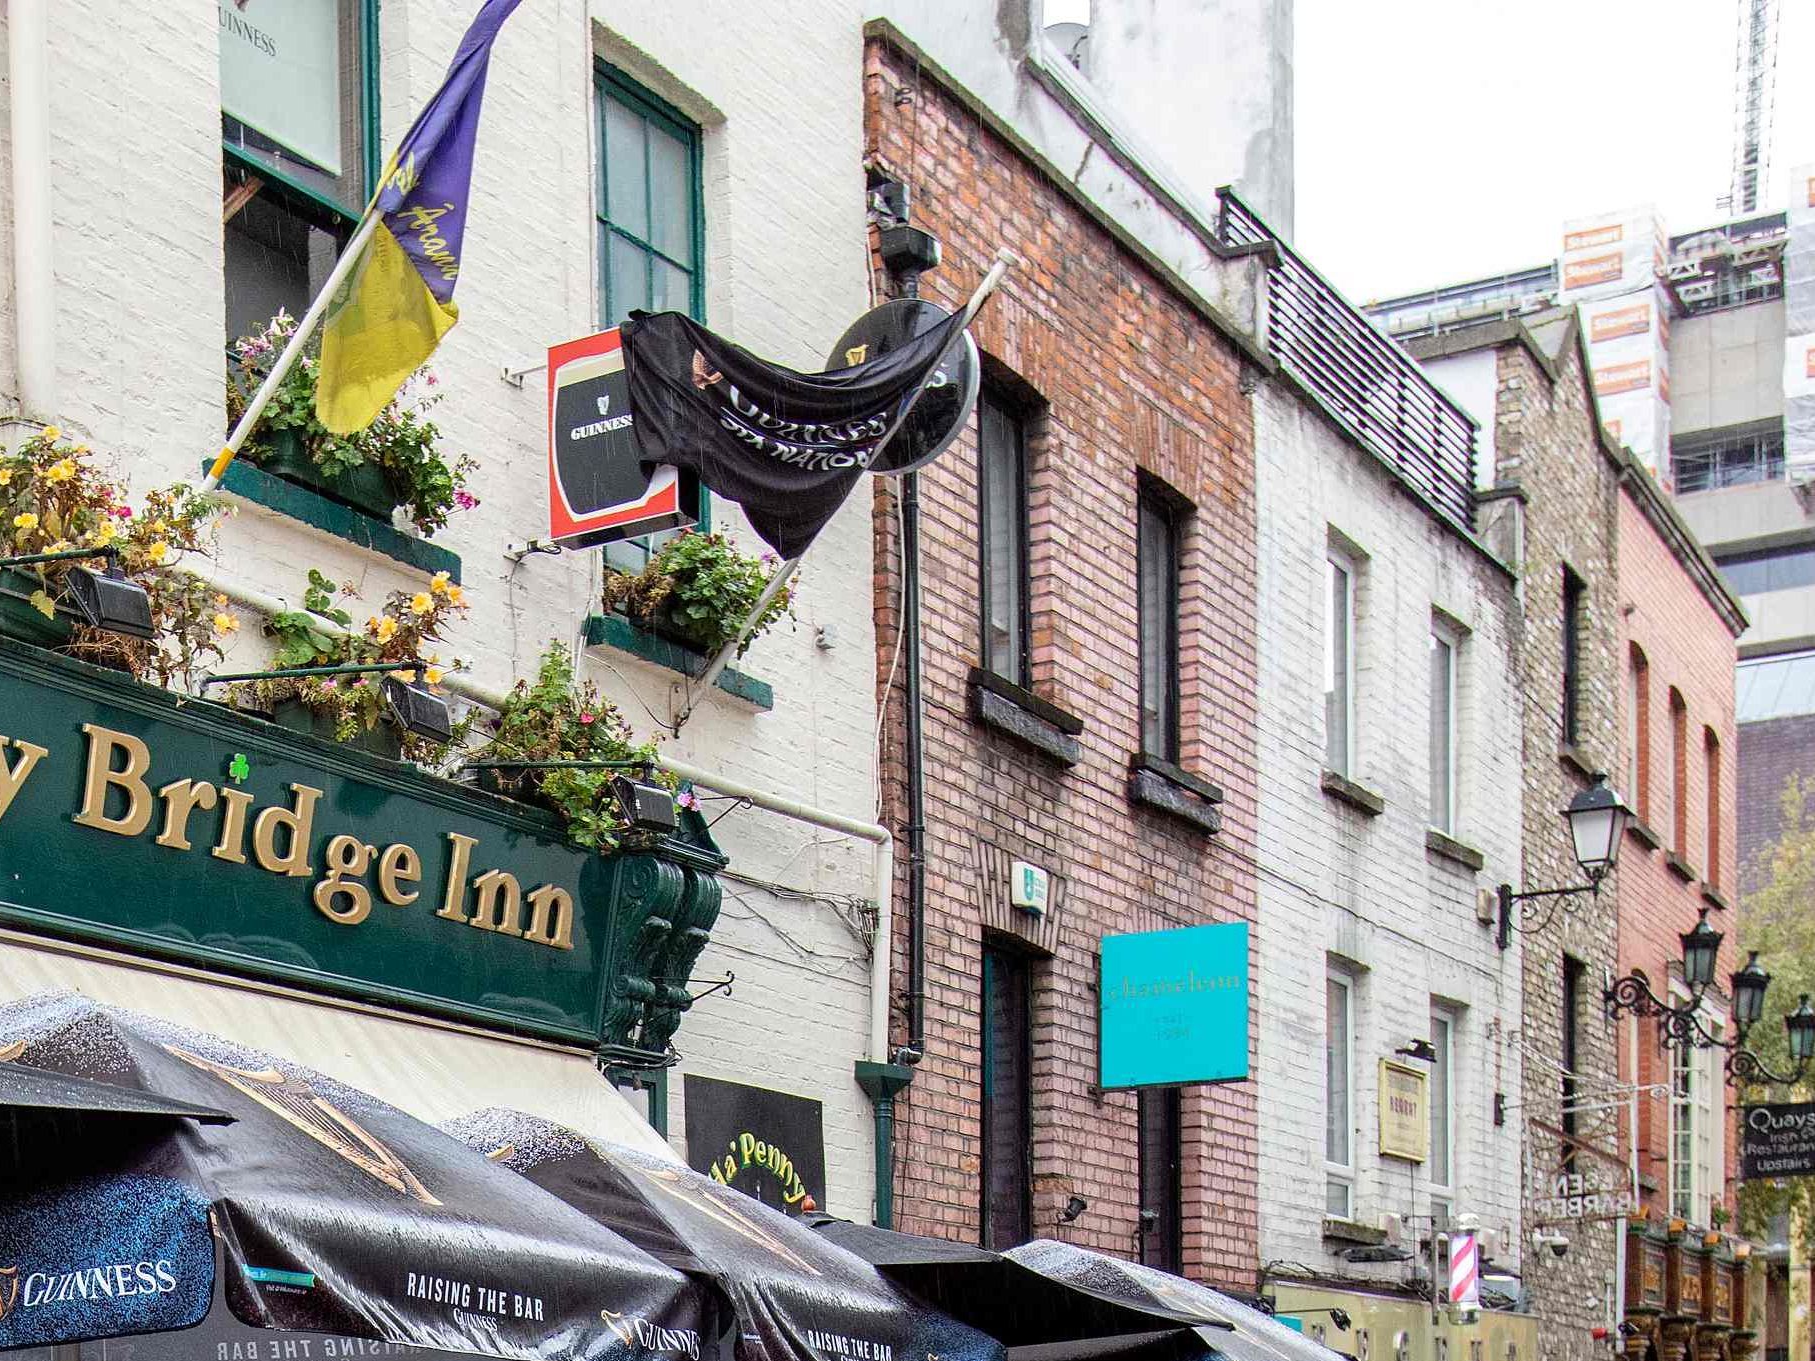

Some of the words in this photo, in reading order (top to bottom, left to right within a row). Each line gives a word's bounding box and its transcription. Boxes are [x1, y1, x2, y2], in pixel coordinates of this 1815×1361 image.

[72, 722, 423, 926] Bridge
[436, 831, 575, 951] Inn
[1749, 1108, 1815, 1134] Quays
[23, 1259, 177, 1308] GUINNESS
[407, 1272, 471, 1308] RAISING
[478, 1287, 506, 1315] THE
[514, 1294, 545, 1322] BAR
[634, 1318, 701, 1361] GUINNES
[807, 1330, 850, 1355] RAISING
[851, 1338, 871, 1361] THE
